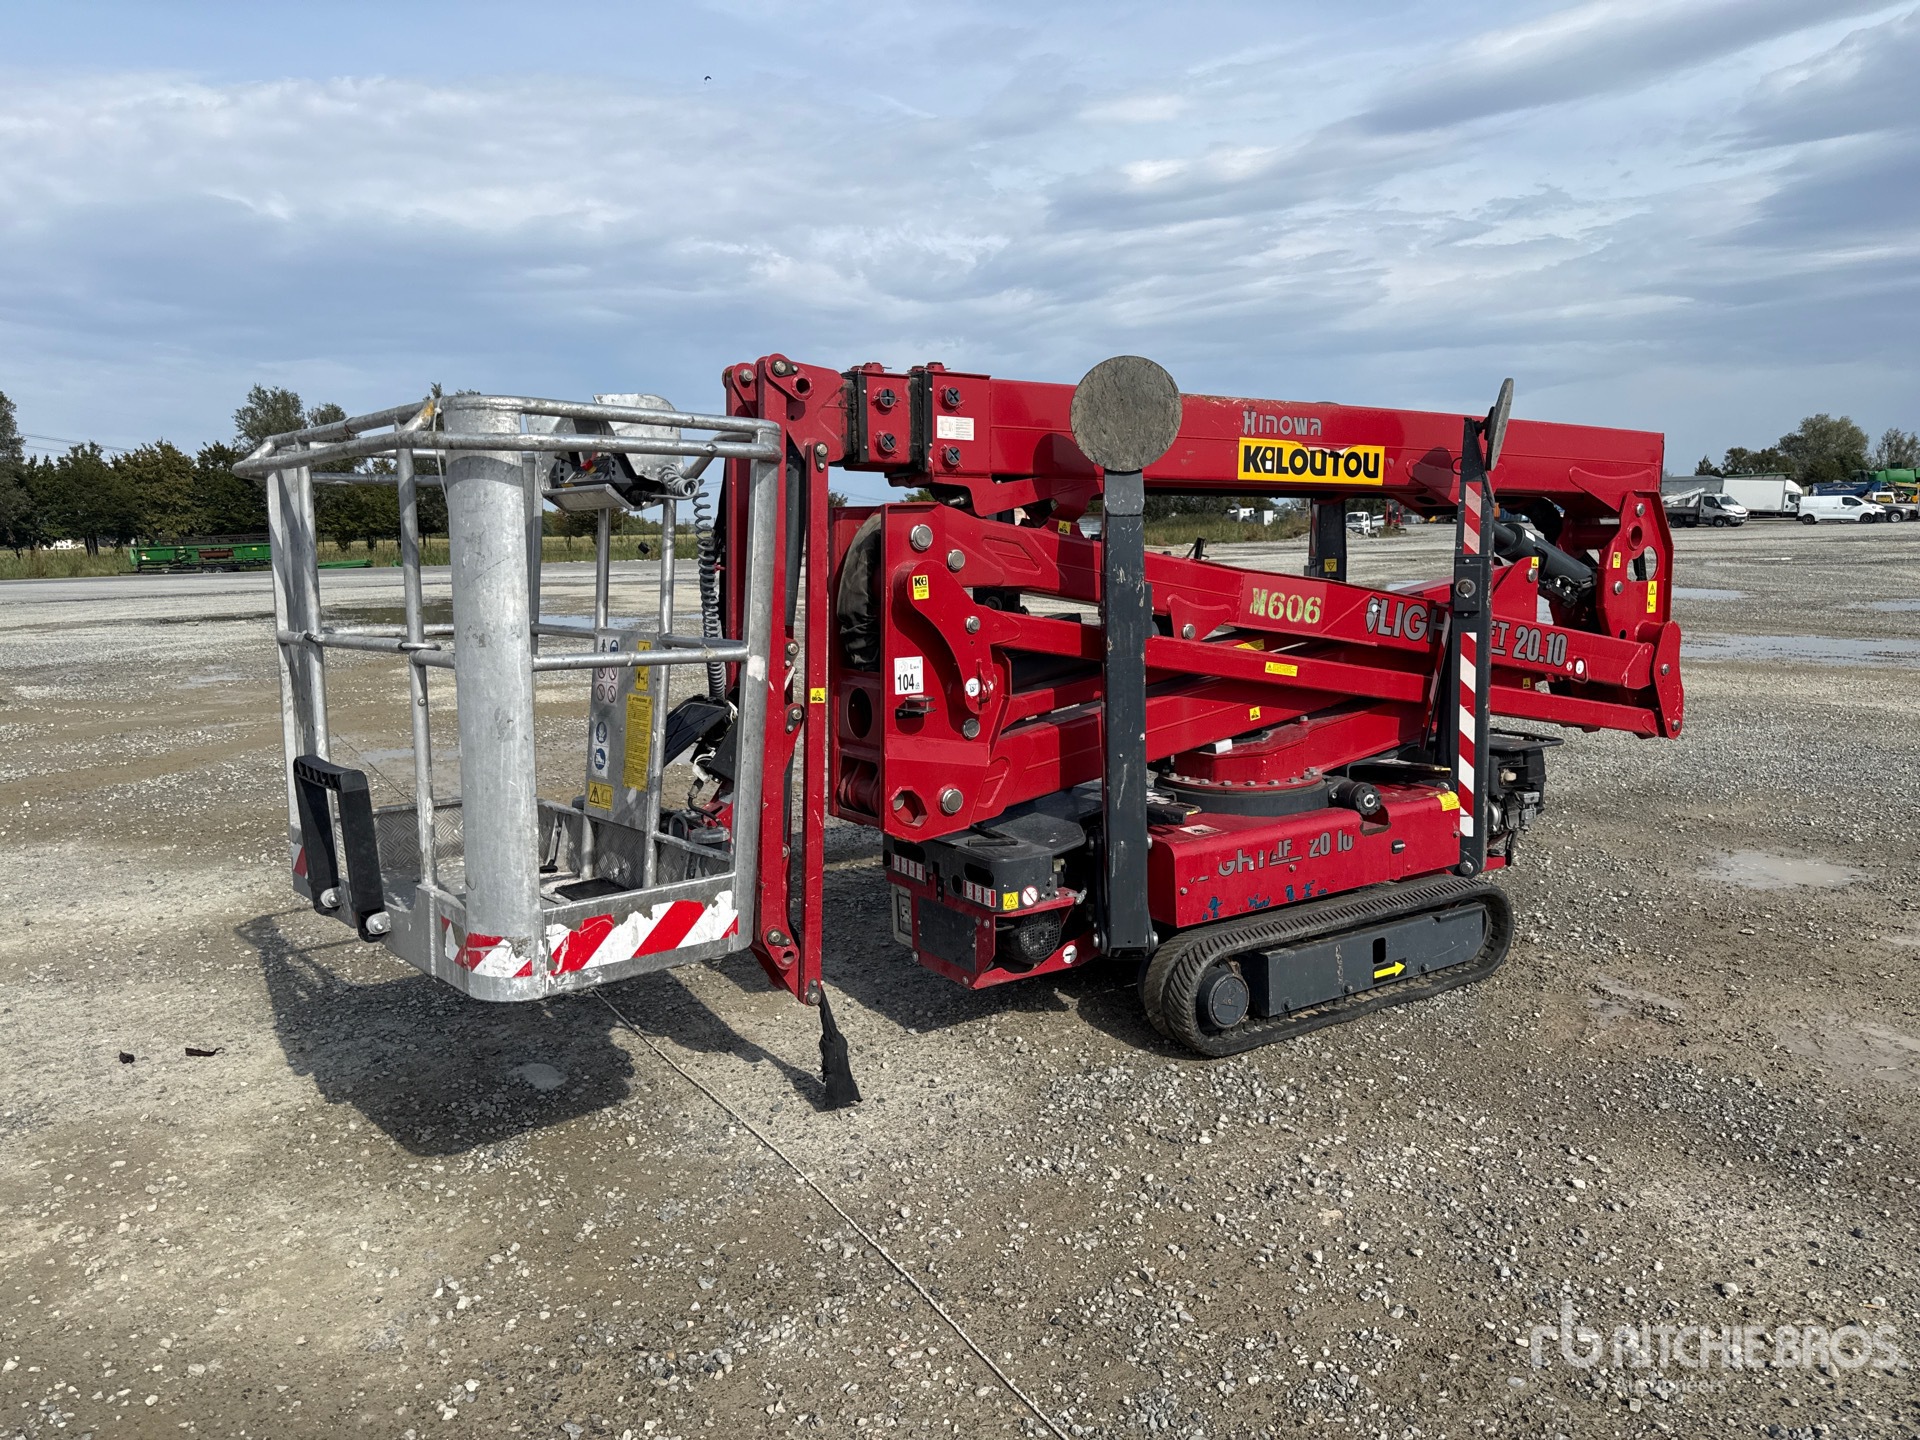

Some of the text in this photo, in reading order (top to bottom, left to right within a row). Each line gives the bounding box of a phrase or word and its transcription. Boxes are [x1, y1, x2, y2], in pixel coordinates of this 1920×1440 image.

[1249, 587, 1322, 624] M606
[1512, 625, 1568, 667] 20.10
[897, 673, 915, 691] 104
